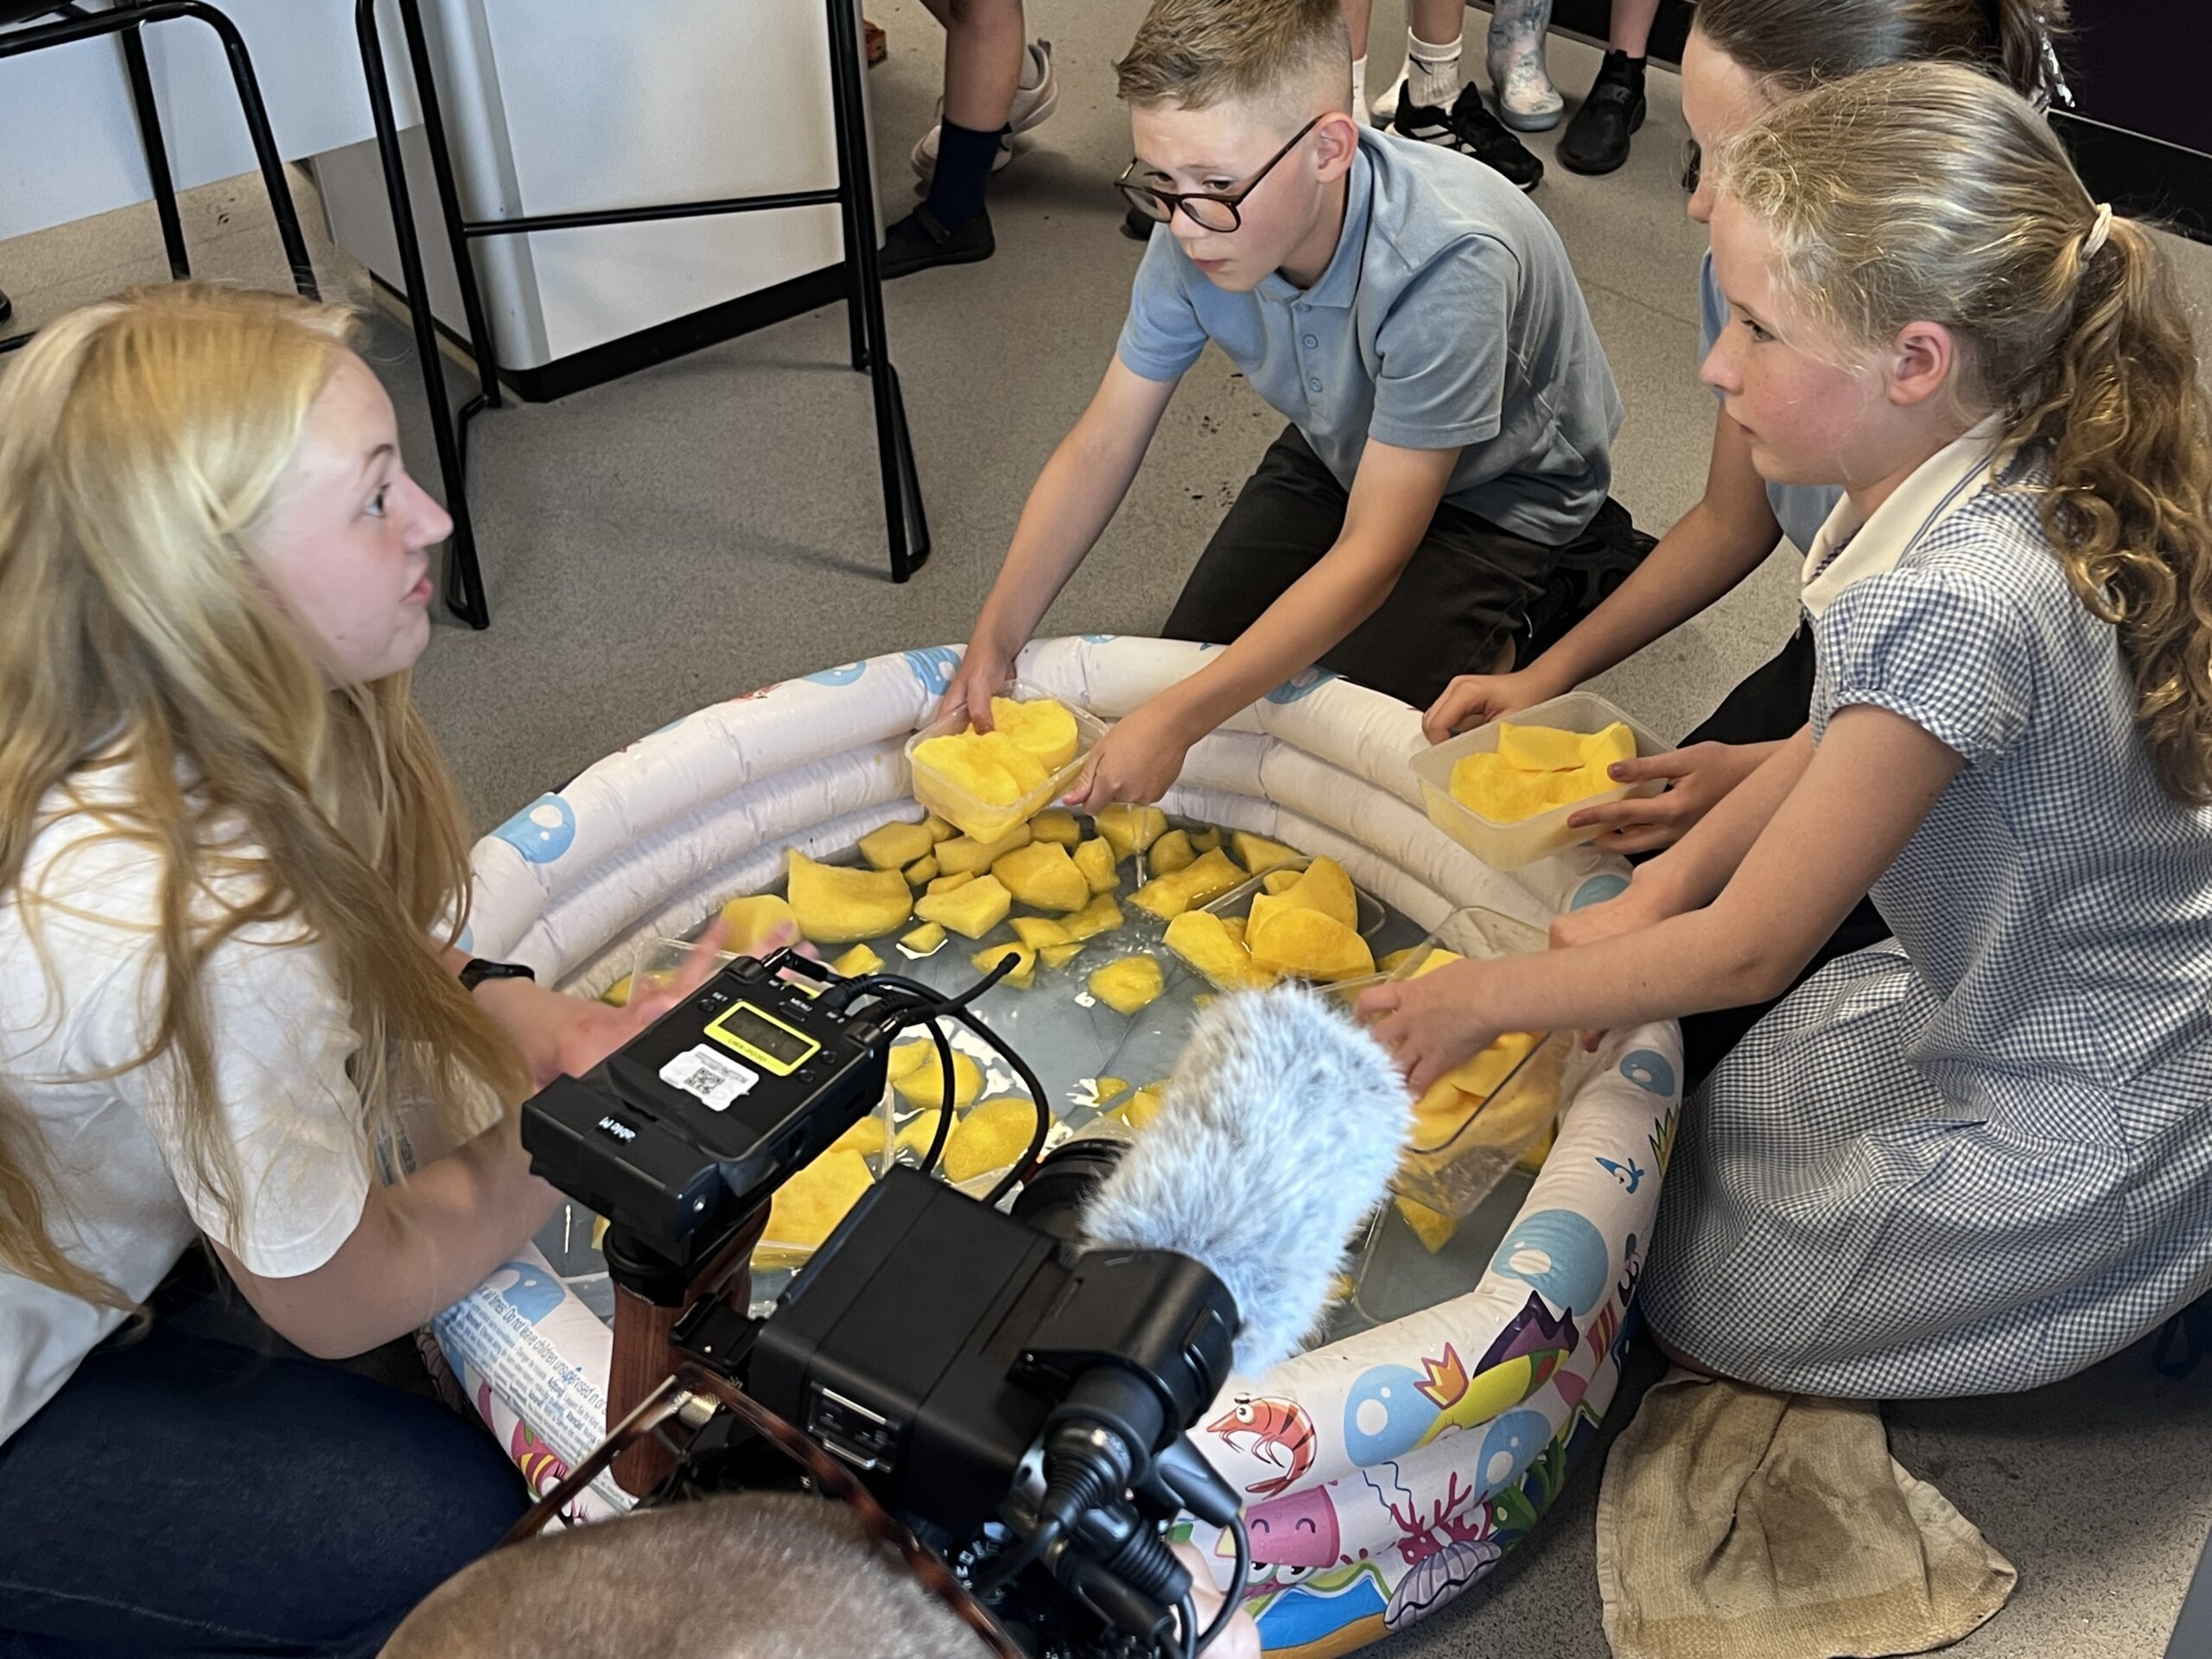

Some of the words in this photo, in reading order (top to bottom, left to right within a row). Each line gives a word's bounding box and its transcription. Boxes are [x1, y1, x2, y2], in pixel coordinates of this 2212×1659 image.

[712, 991, 728, 1002] SET
[790, 997, 813, 1012] MENU
[511, 1318, 526, 1333] not
[519, 1325, 538, 1345] leave
[532, 1339, 558, 1366] children
[553, 1360, 596, 1398] unsupervised
